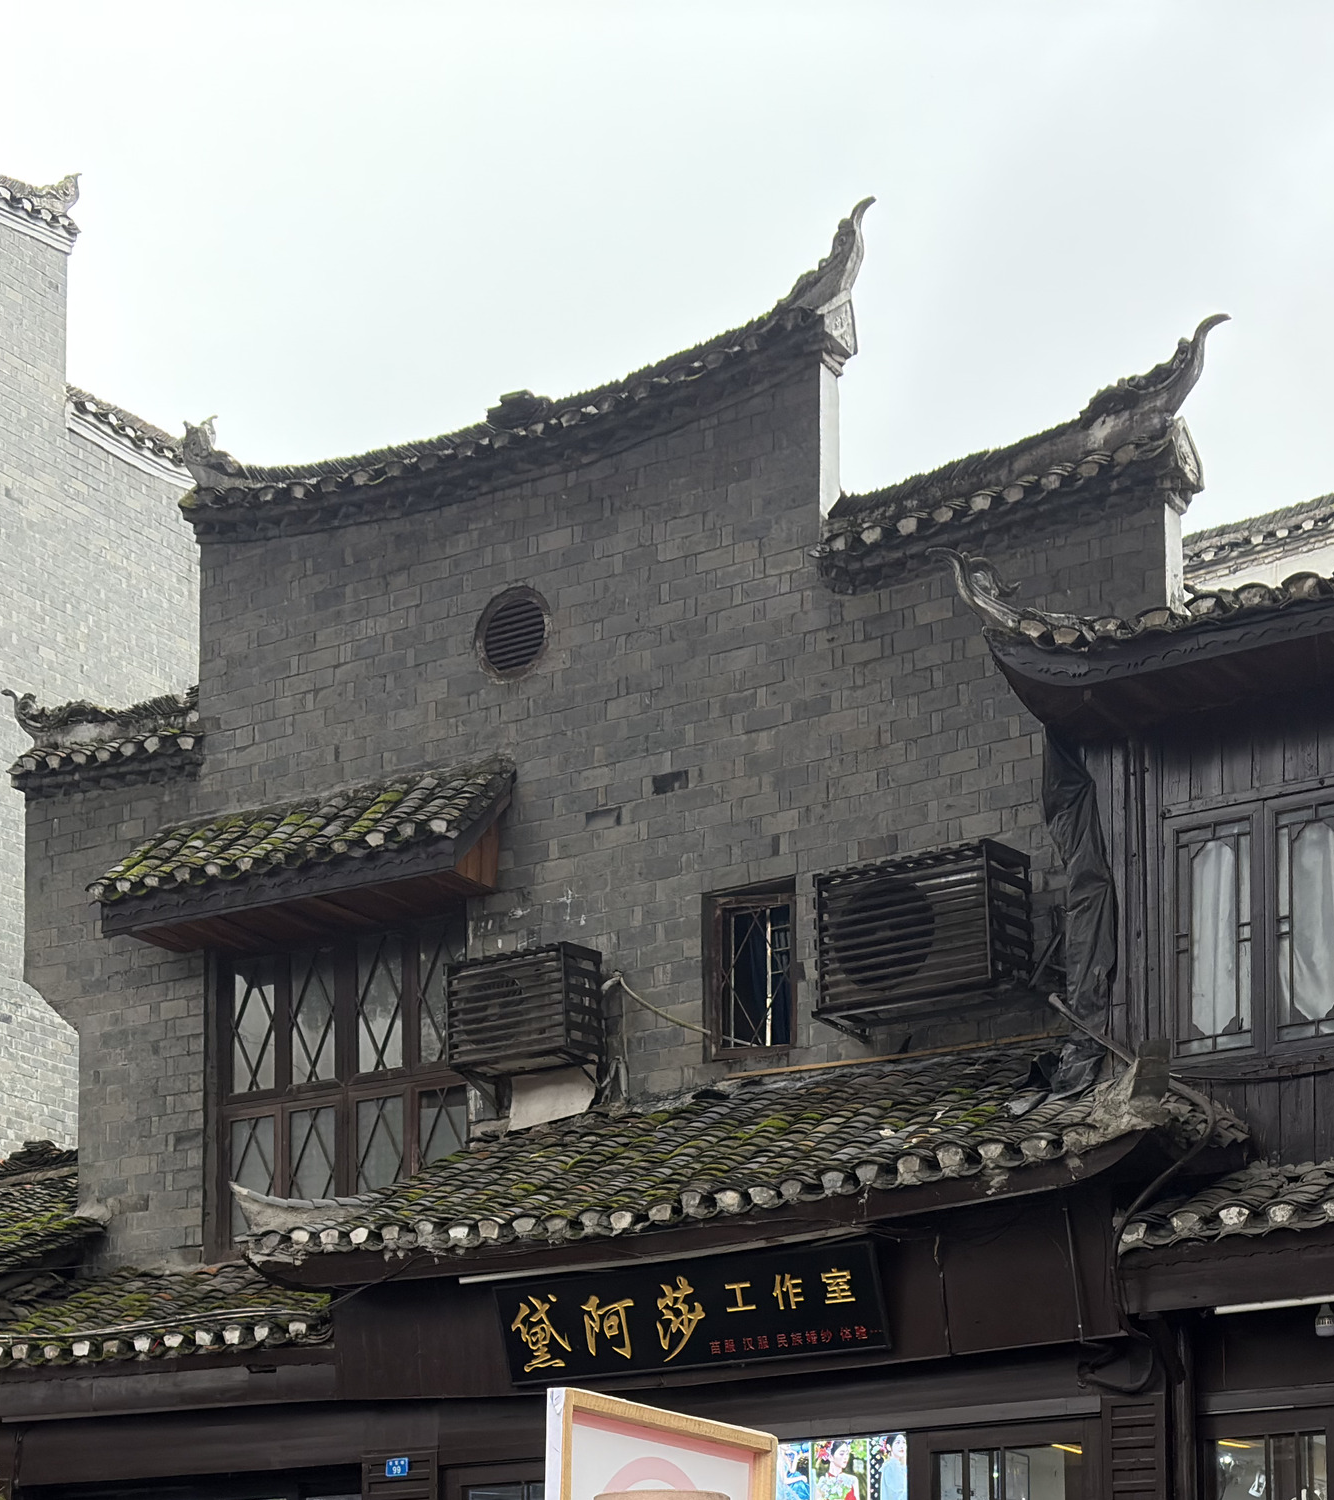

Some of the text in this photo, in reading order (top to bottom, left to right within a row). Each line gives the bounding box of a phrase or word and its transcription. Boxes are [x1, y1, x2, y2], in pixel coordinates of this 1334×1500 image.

[709, 1339, 737, 1354] 苗服
[742, 1335, 770, 1351] 汉服
[776, 1329, 833, 1348] 民族婚纱
